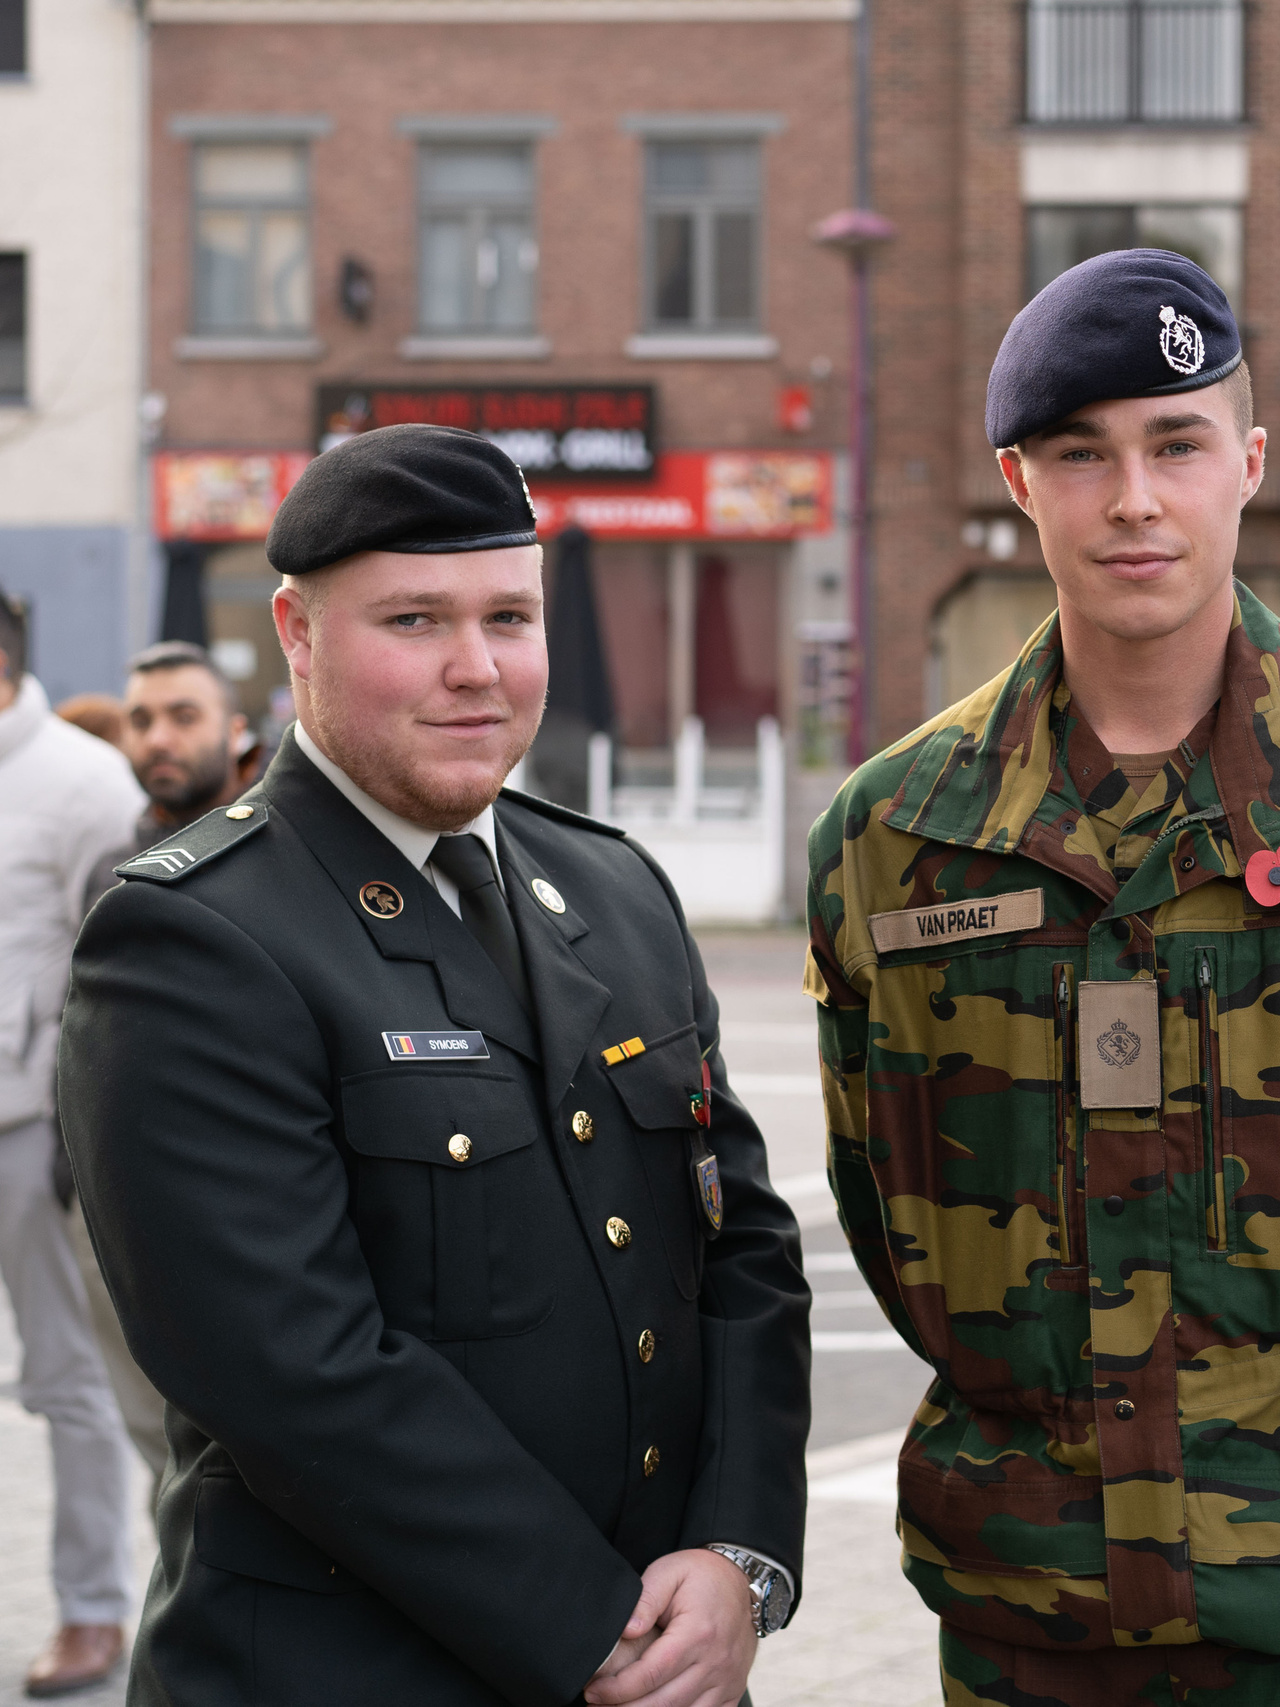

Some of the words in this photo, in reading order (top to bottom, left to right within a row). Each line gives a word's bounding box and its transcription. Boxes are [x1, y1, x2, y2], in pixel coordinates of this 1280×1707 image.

[917, 912, 945, 937] VAN
[949, 905, 999, 934] PRAET
[428, 1039, 469, 1050] SYMOENS
